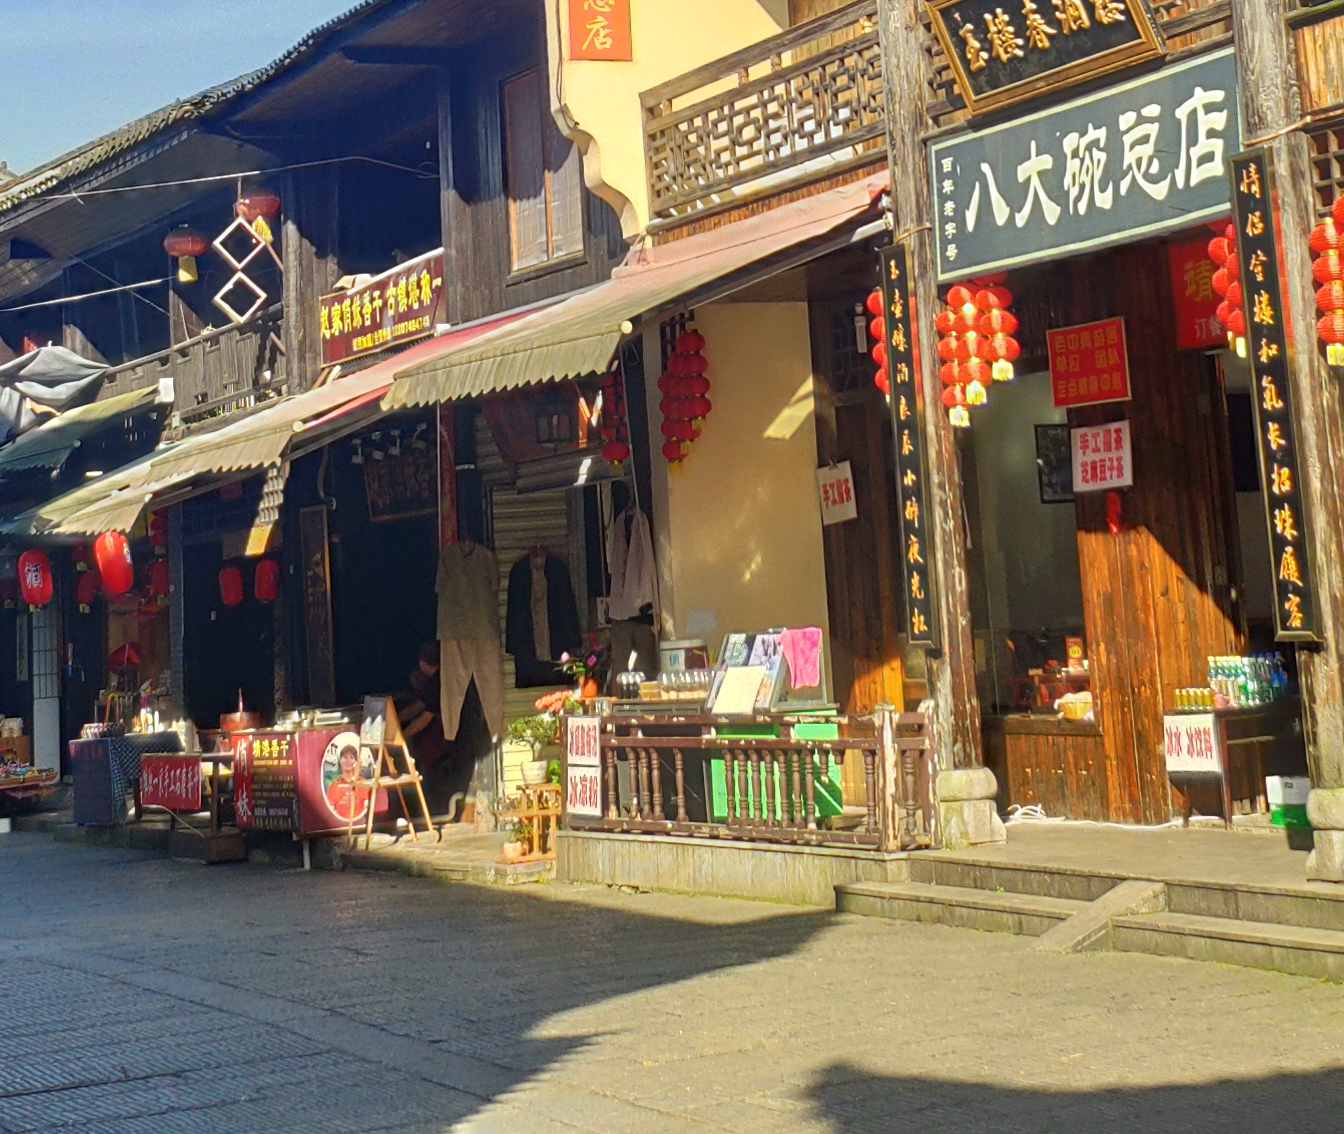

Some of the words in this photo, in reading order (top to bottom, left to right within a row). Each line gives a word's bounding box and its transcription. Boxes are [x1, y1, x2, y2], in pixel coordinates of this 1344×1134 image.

[940, 155, 959, 262] 百年老字号
[965, 85, 1229, 233] 八大碗总店
[1079, 454, 1125, 485] 芝麻豆子茶
